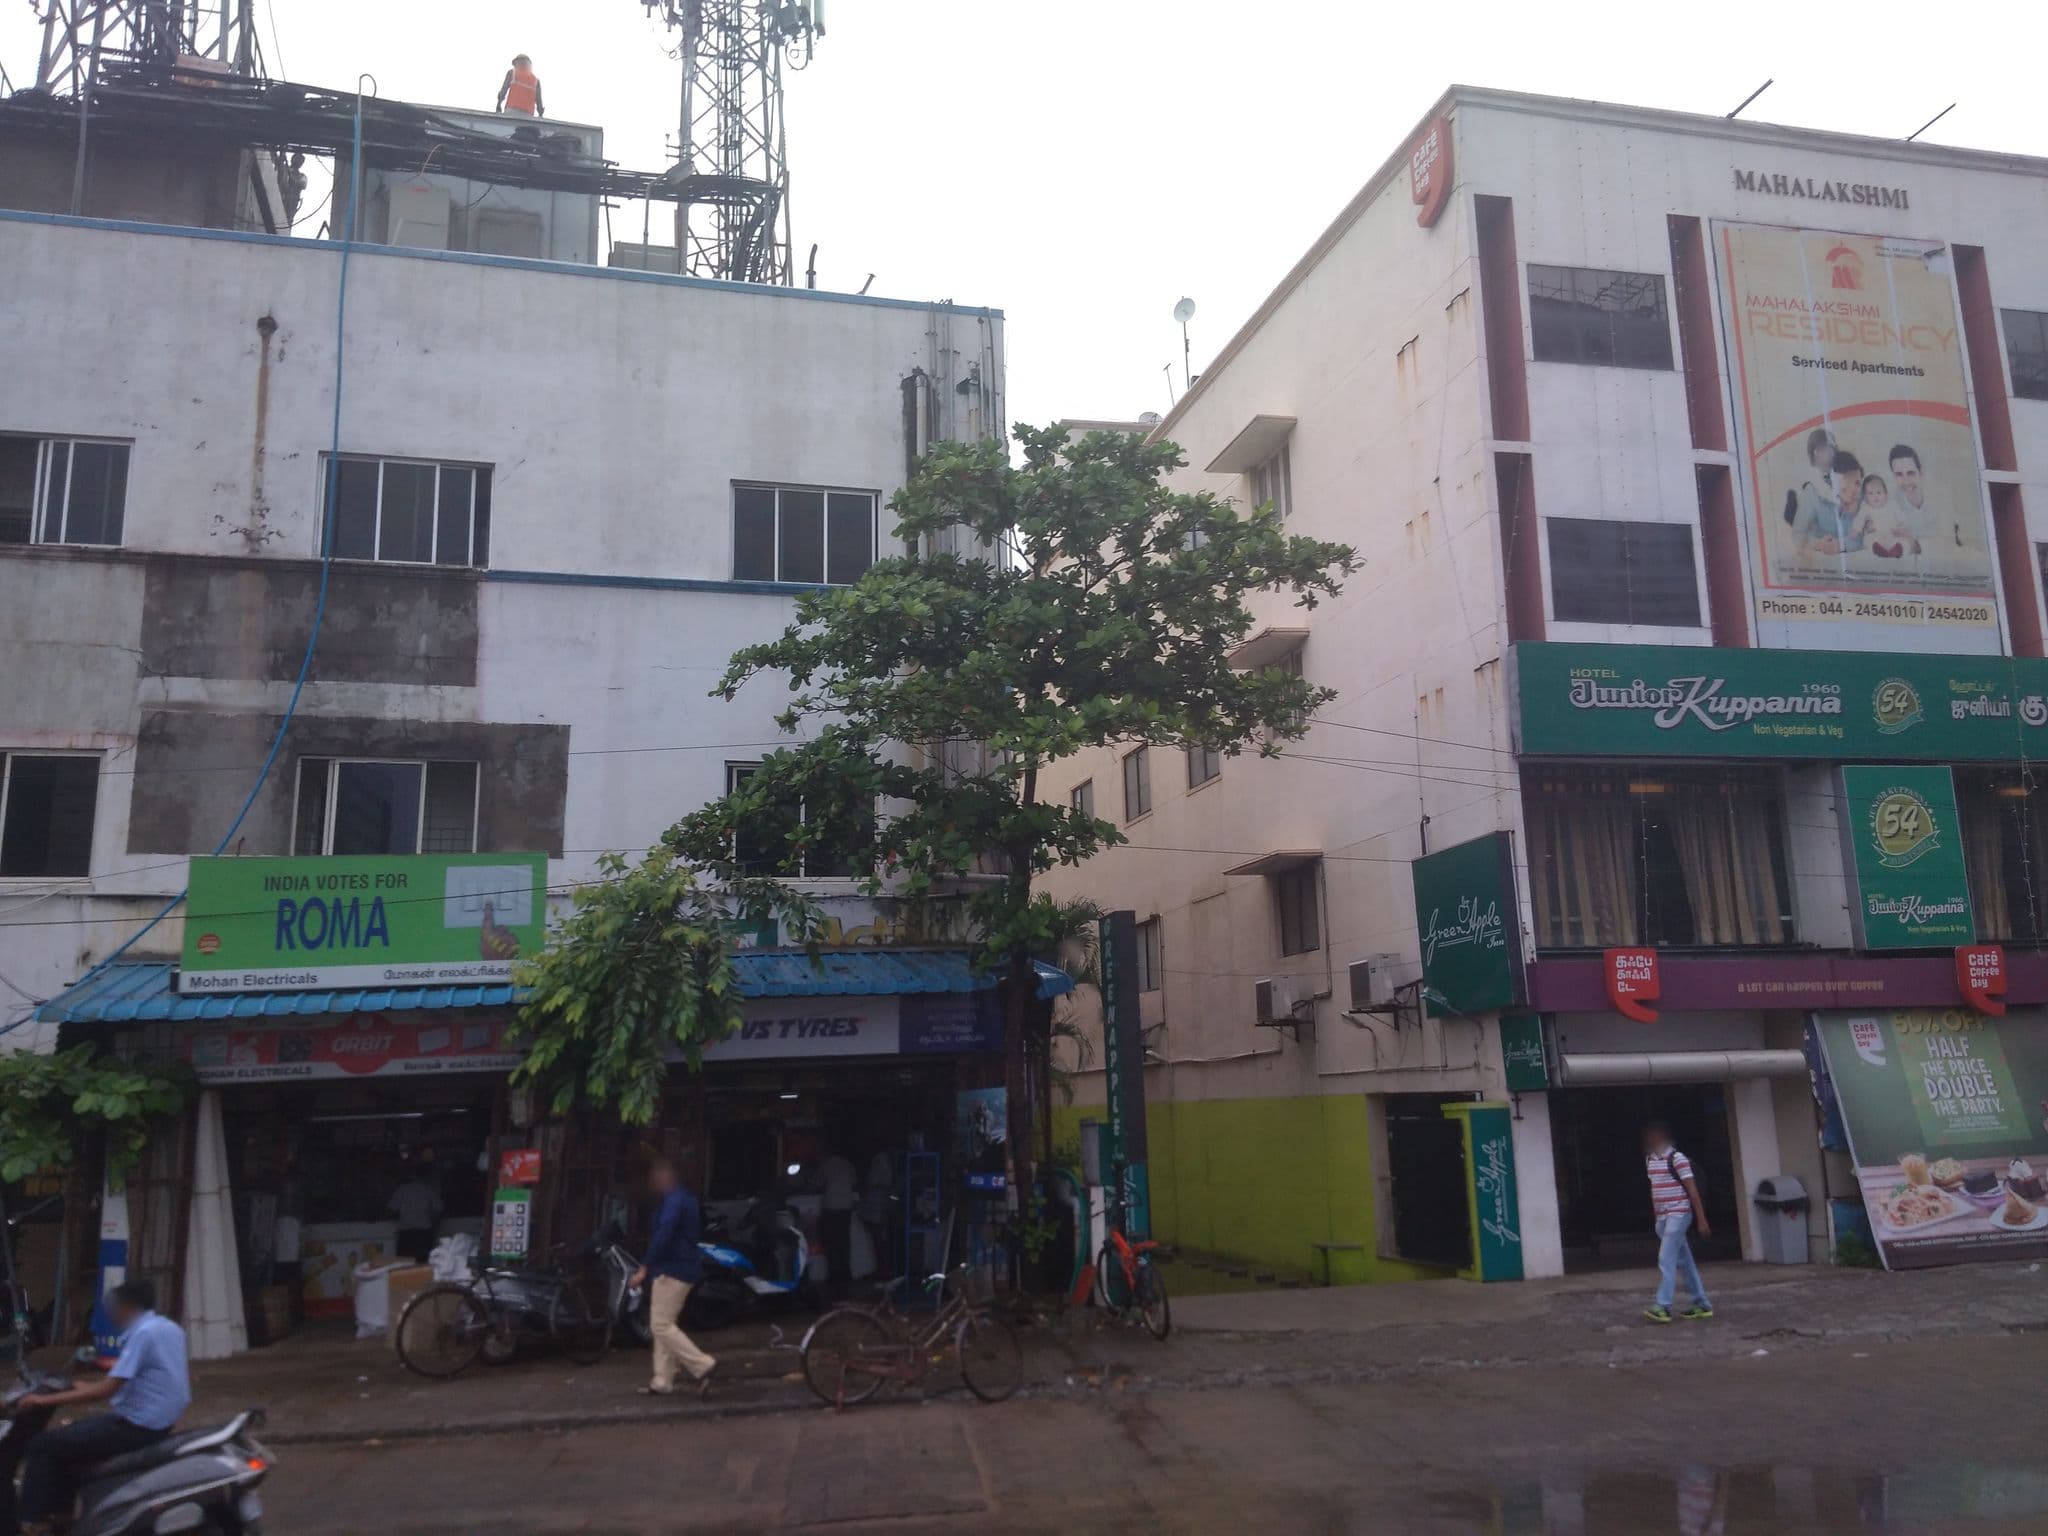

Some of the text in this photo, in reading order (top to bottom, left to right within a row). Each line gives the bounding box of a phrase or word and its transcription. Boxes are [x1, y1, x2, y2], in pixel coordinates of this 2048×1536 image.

[1734, 168, 1909, 210] MAHALAKSHMI
[1745, 294, 1881, 318] MAHALAKSHMI
[1747, 310, 1956, 353] RESIDENCY
[1791, 354, 1925, 377] Serviced Apartments
[1761, 600, 1806, 615] Phone
[1819, 602, 1843, 615] 044
[1855, 603, 1917, 618] 24541010
[1928, 606, 1988, 621] 24542020
[1569, 667, 1621, 679] HOTEL
[1801, 684, 1841, 694] 1960
[1569, 678, 1685, 709] Junior
[1654, 676, 1842, 731] Kuppanna
[1879, 689, 1908, 714] 54
[1753, 724, 1771, 735] Non
[1772, 725, 1817, 738] Vegetarian
[1827, 726, 1844, 739] Veg
[1881, 803, 1920, 840] 54
[264, 873, 408, 892] INDIA VOTES FOR
[1869, 895, 1964, 924] Junior Kuppanna
[275, 896, 391, 951] ROMA
[1421, 896, 1501, 967] Green Apple
[189, 973, 318, 989] Mohan Electricals
[778, 1016, 862, 1038] TYRES
[1925, 1036, 1970, 1058] HALF
[1920, 1058, 1991, 1077] THE PRICE.
[1923, 1074, 1999, 1101] DOUBLE
[1931, 1097, 2005, 1117] THE PARTY.
